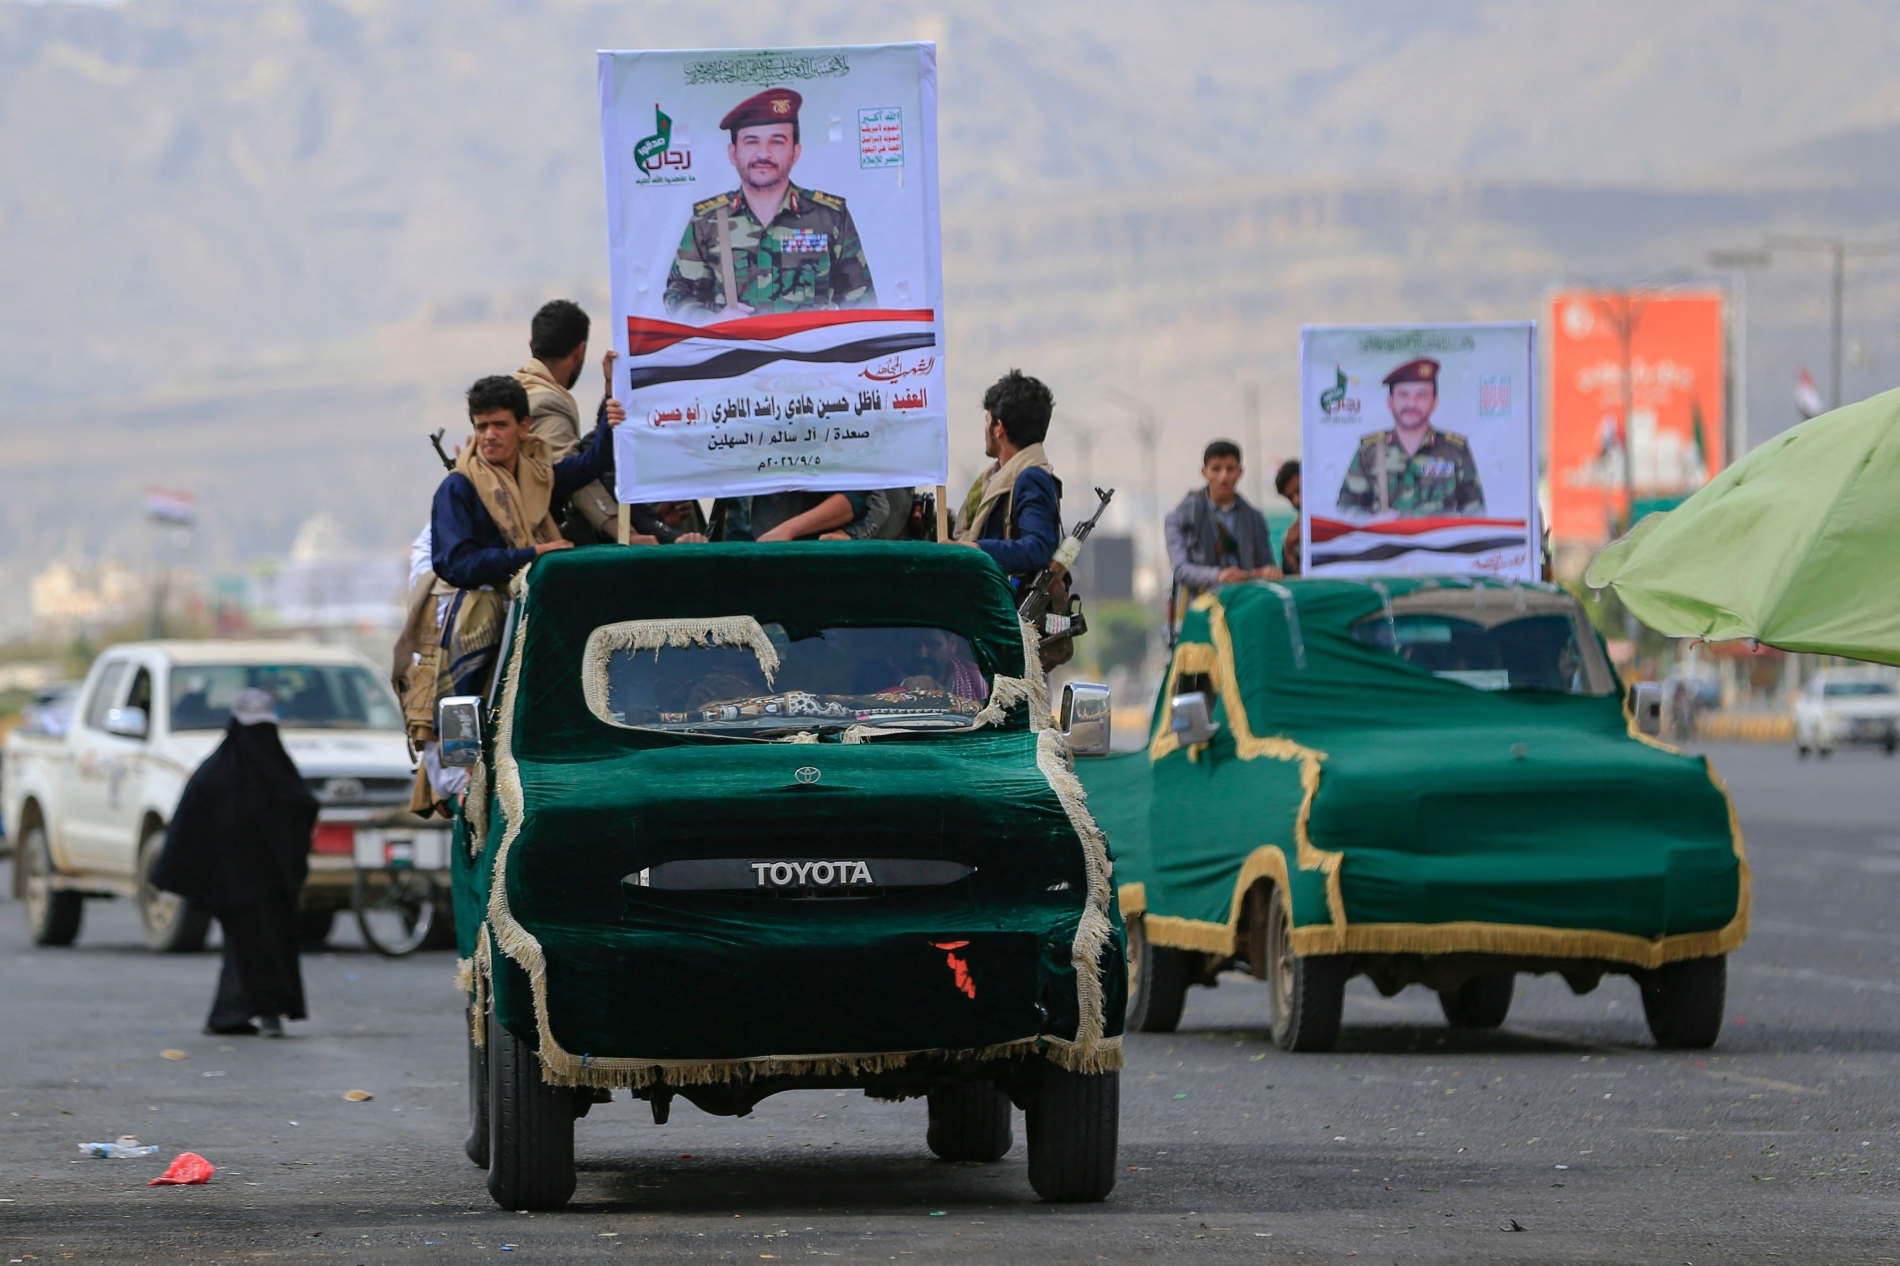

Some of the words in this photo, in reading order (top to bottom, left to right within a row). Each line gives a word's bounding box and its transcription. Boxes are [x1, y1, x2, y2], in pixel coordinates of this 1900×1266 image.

[645, 150, 691, 170] رجال
[754, 395, 781, 420] راشد
[784, 394, 814, 425] هادي
[817, 396, 849, 419] حسين
[893, 387, 927, 414] العقيد
[708, 432, 753, 450] السهلين
[768, 430, 798, 445] سالم
[833, 427, 870, 441] صعدة
[750, 860, 875, 885] TOYOTA
